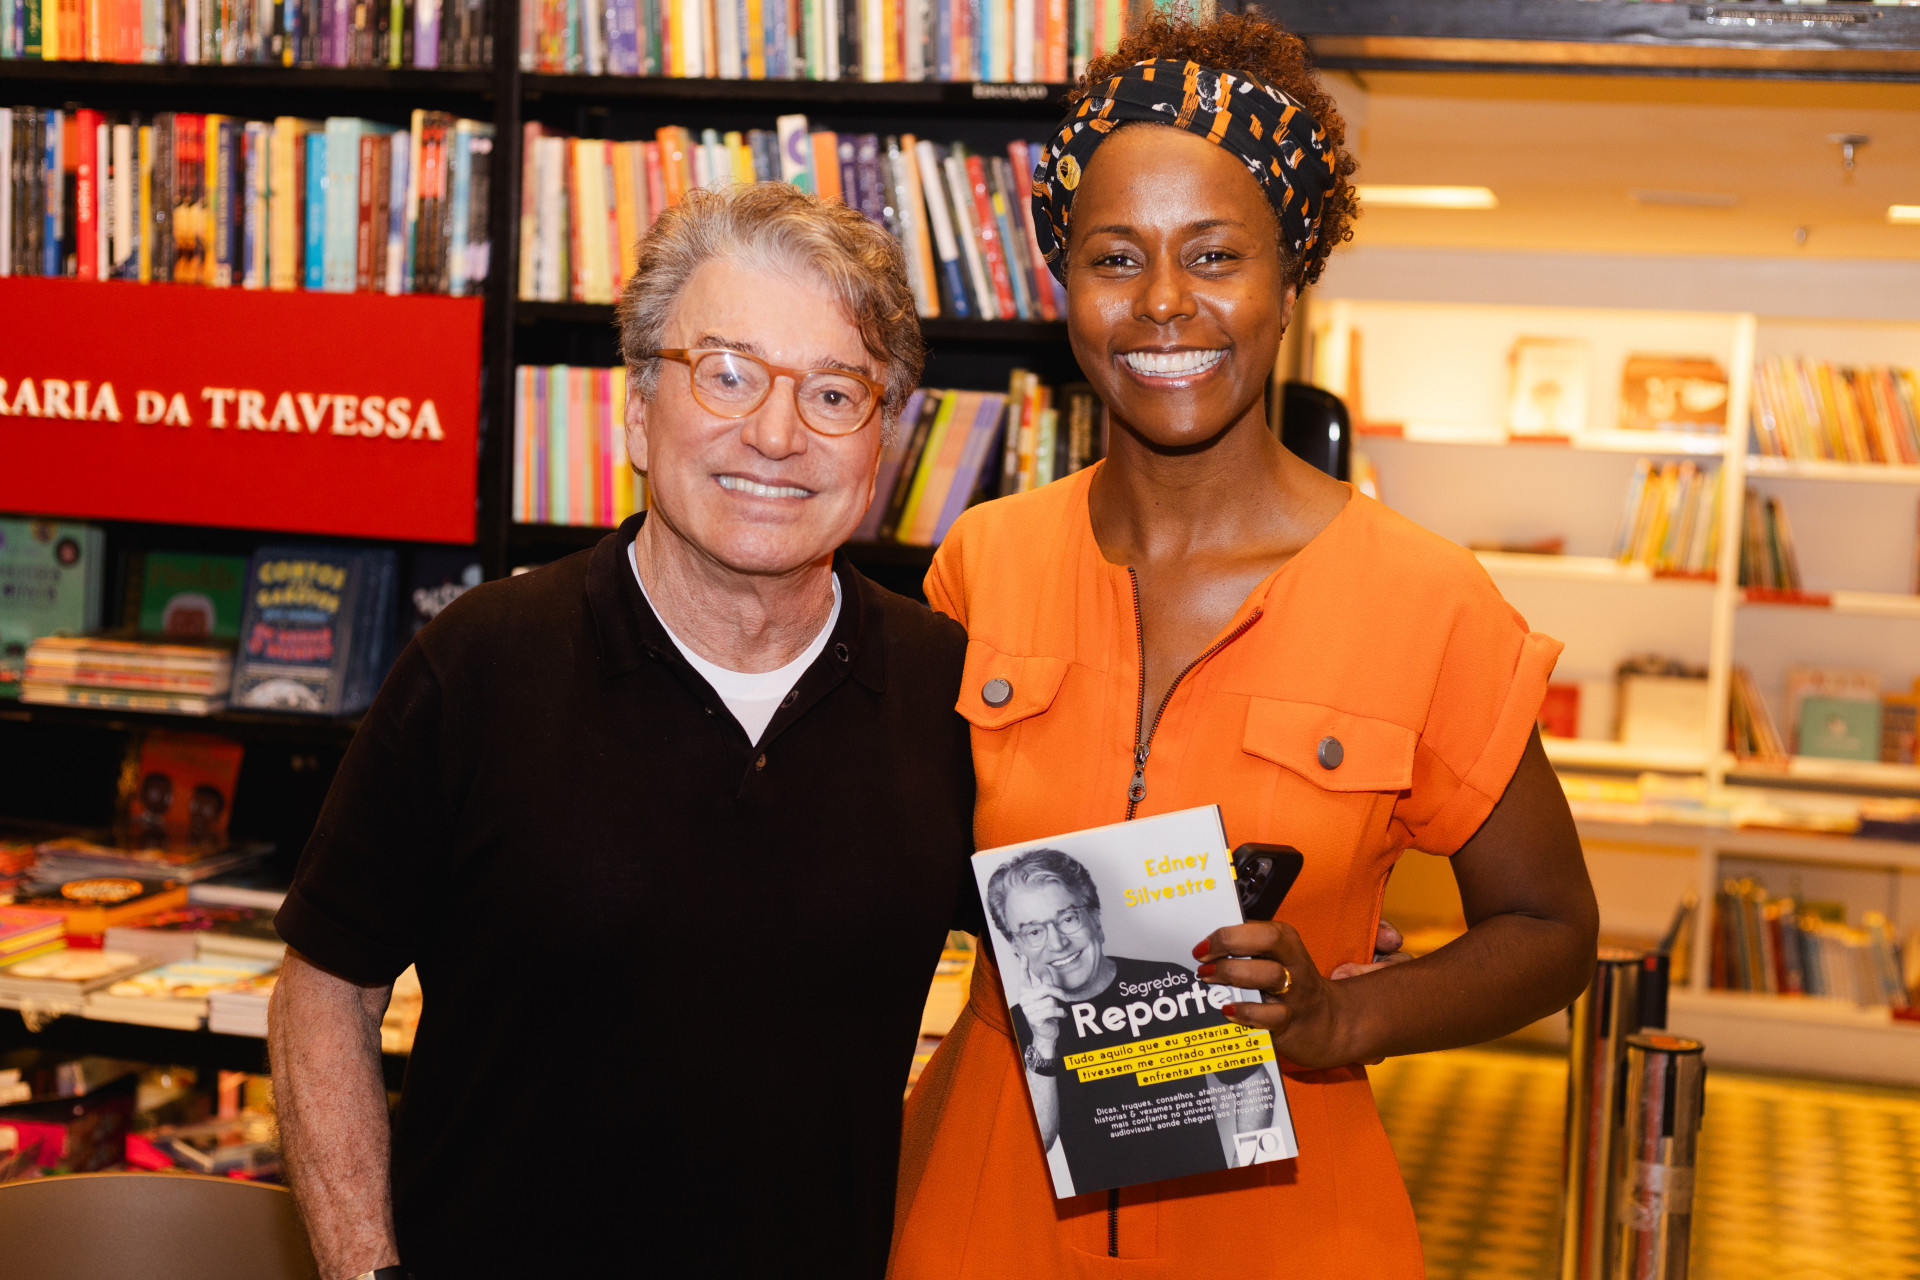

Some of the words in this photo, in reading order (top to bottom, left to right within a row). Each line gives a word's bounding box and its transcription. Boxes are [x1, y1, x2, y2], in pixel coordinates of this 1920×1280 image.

[135, 389, 193, 428] DA
[201, 386, 445, 441] TRAVESSA
[1144, 852, 1208, 876] Edney
[1123, 877, 1216, 907] Silvestre
[1119, 971, 1188, 997] Segredos
[1068, 1052, 1094, 1066] Tudo
[1100, 1046, 1133, 1059] aquilo
[1139, 1042, 1159, 1053] que
[1165, 1038, 1178, 1046] eu
[1184, 1027, 1229, 1045] gostaria
[1082, 1063, 1133, 1079] tivessem
[1138, 1059, 1154, 1068] me
[1160, 1048, 1204, 1064] contado
[1210, 1042, 1240, 1054] antes
[1245, 1038, 1259, 1047] de
[1143, 1066, 1193, 1083] enfrentar
[1200, 1064, 1211, 1072] as
[1217, 1054, 1263, 1069] câmeras
[1129, 1110, 1136, 1118] &
[1140, 1104, 1173, 1116] vexames
[1175, 1100, 1193, 1110] para
[1196, 1095, 1218, 1106] quem
[1220, 1091, 1243, 1102] quiser
[1247, 1086, 1271, 1095] entrar
[1198, 1085, 1226, 1097] atalhos
[1238, 1078, 1269, 1089] algumas
[1111, 1120, 1129, 1129] mais
[1131, 1113, 1168, 1125] confiante
[1183, 1104, 1216, 1116] universo
[1234, 1094, 1273, 1108] jornalismo
[1156, 1119, 1180, 1130] aonde
[1183, 1113, 1214, 1125] cheguei
